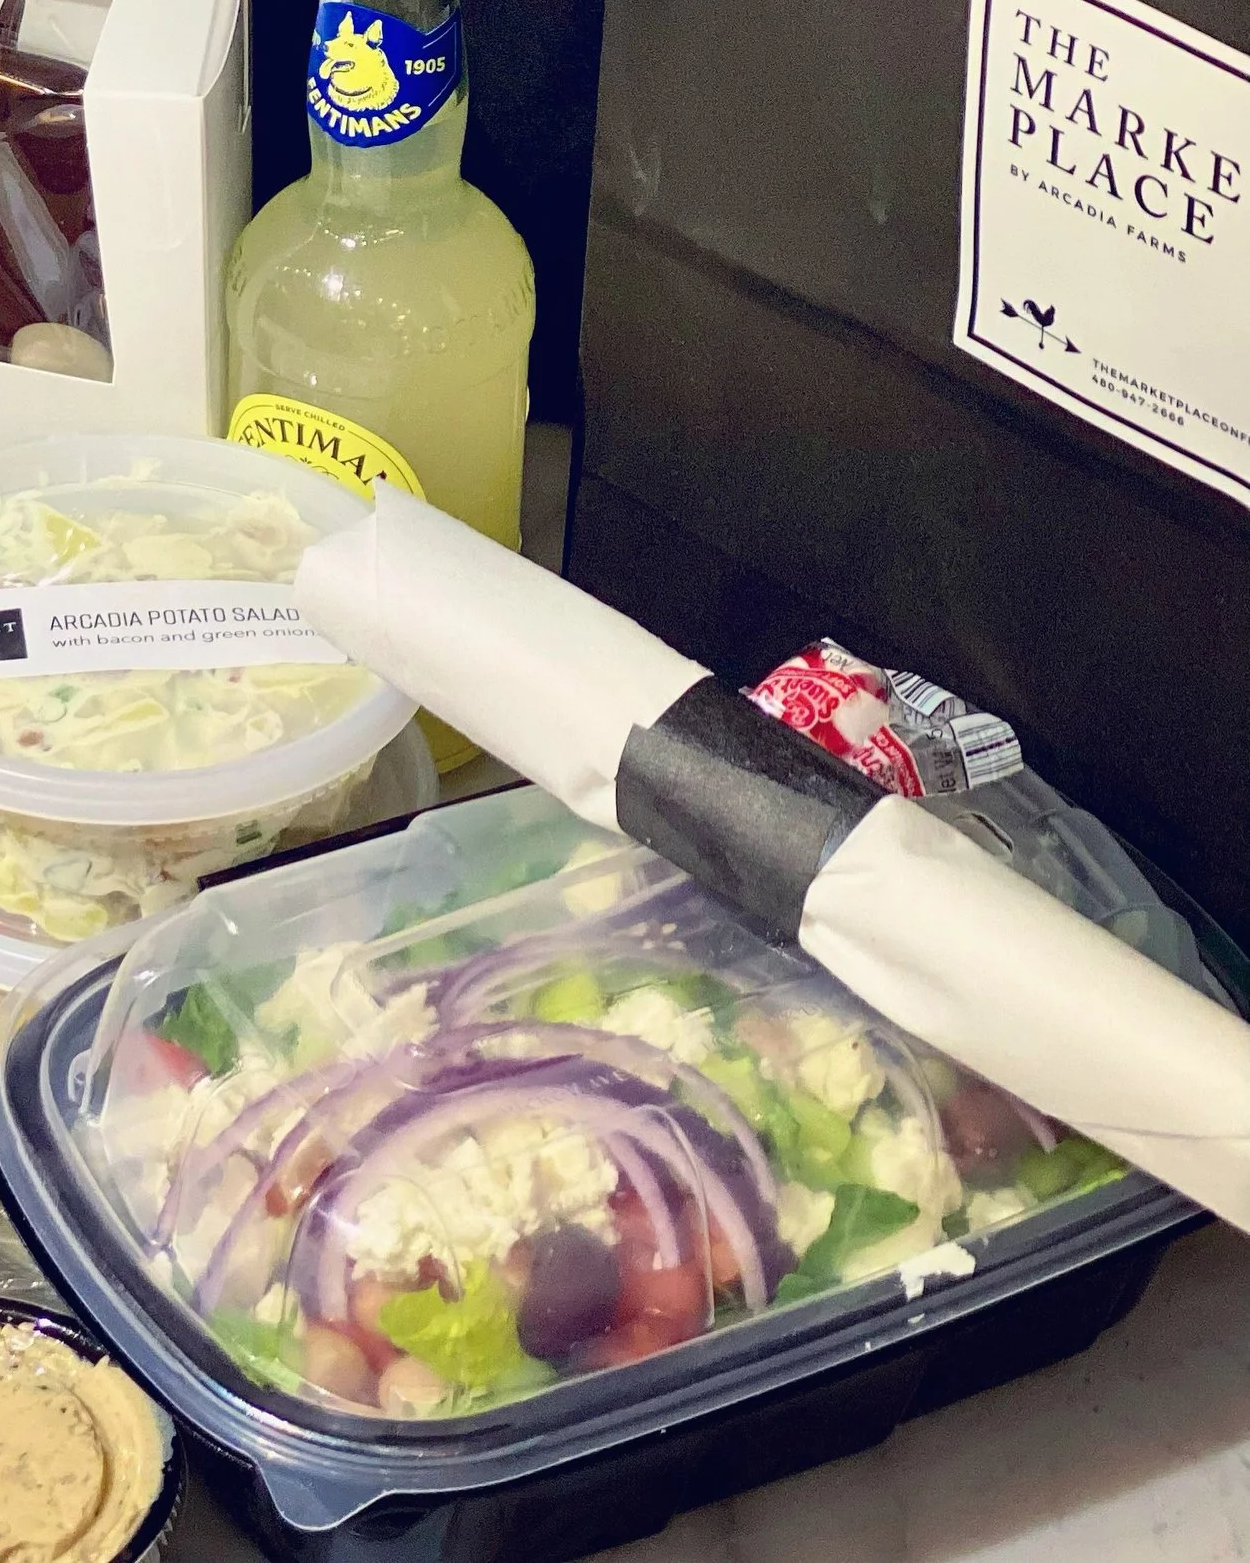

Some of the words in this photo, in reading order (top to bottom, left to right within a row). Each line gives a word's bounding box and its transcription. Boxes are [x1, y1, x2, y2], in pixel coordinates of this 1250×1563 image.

[405, 56, 446, 75] 1905
[1016, 9, 1111, 81] THE
[307, 77, 422, 137] FENTIMANS
[1010, 52, 1242, 204] MARKE
[1007, 104, 1215, 245] PLACE
[1010, 164, 1030, 181] BY
[1038, 179, 1117, 229] ARCADIA
[1127, 224, 1188, 264] FARMS
[275, 403, 302, 416] SERVE
[304, 410, 345, 431] CHILLED
[1091, 374, 1185, 427] 480-947-2666
[238, 417, 387, 486] ENTIMA
[50, 611, 143, 631] ARCADIA
[148, 607, 227, 626] POTATO
[232, 607, 300, 622] SALAD
[52, 634, 92, 648] with
[96, 631, 155, 645] bacon
[160, 629, 196, 642] and
[201, 628, 257, 643] green
[262, 627, 319, 637] onion
